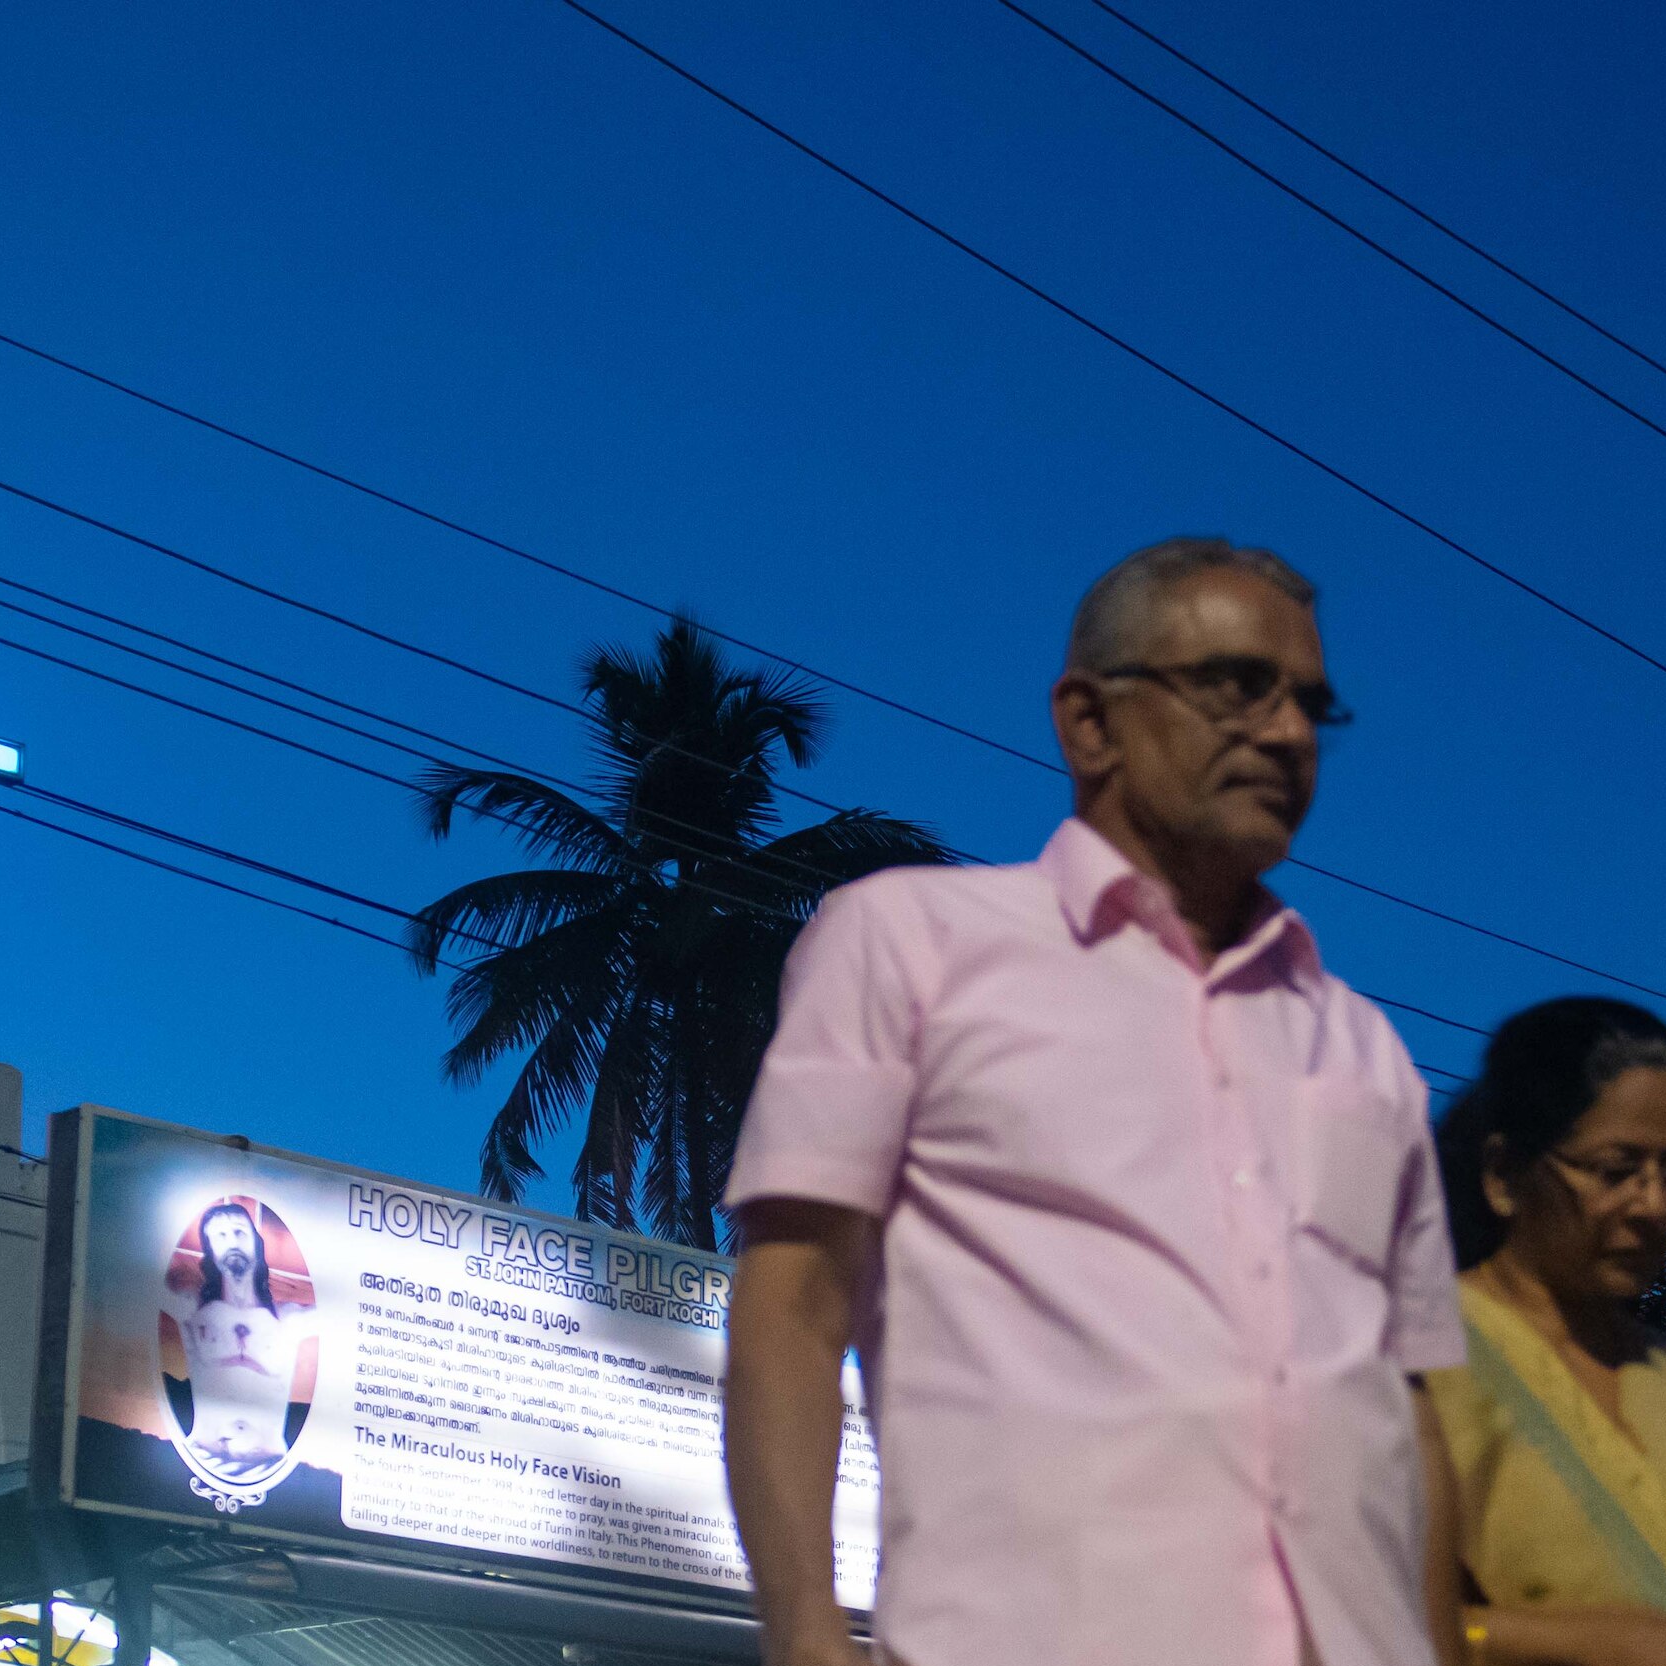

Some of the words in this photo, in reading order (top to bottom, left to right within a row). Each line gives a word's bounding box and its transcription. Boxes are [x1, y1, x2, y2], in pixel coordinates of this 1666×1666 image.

[348, 1183, 471, 1250] HOLY
[482, 1214, 593, 1279] FACE
[357, 1302, 381, 1316] 1998
[457, 1323, 463, 1332] 4
[360, 1269, 441, 1304] അത്ഭുത
[448, 1288, 527, 1321] തിരുമുഖ
[531, 1307, 580, 1335] ദൃശ്യം
[465, 1256, 491, 1279] ST.
[494, 1261, 541, 1291] JOHN
[544, 1271, 617, 1310] PATTOM,
[619, 1285, 665, 1318] FORT
[667, 1296, 720, 1331] KOCHI
[687, 1386, 707, 1401] വന്ന
[353, 1426, 385, 1447] The
[391, 1433, 485, 1464] Miraculous
[490, 1450, 527, 1475] Holy
[532, 1458, 567, 1479] Face
[572, 1465, 621, 1489] Vision
[536, 1488, 553, 1499] red
[557, 1489, 586, 1504] letter
[589, 1495, 609, 1511] day
[612, 1498, 621, 1511] in
[625, 1501, 641, 1515] the
[645, 1506, 687, 1522] spiritual
[691, 1515, 725, 1528] annals
[565, 1509, 576, 1520] to
[579, 1512, 605, 1527] pray,
[608, 1518, 629, 1529] was
[631, 1519, 661, 1534] given
[663, 1527, 669, 1536] a
[673, 1527, 730, 1545] miraculous
[350, 1506, 387, 1526] falling
[391, 1514, 433, 1531] deeper
[435, 1524, 457, 1534] and
[461, 1526, 501, 1542] deeper
[504, 1535, 527, 1545] into
[530, 1539, 595, 1559] worldliness,
[598, 1547, 609, 1560] to
[612, 1551, 645, 1565] return
[648, 1556, 659, 1567] to
[662, 1557, 679, 1571] the
[682, 1563, 709, 1575] cross
[711, 1565, 723, 1577] of
[725, 1568, 741, 1580] the
[529, 1520, 541, 1530] of
[544, 1521, 571, 1536] Turin
[575, 1525, 585, 1538] in
[587, 1528, 613, 1545] Italy.
[616, 1532, 637, 1547] This
[641, 1537, 711, 1559] Phenomenon
[714, 1552, 732, 1562] can
